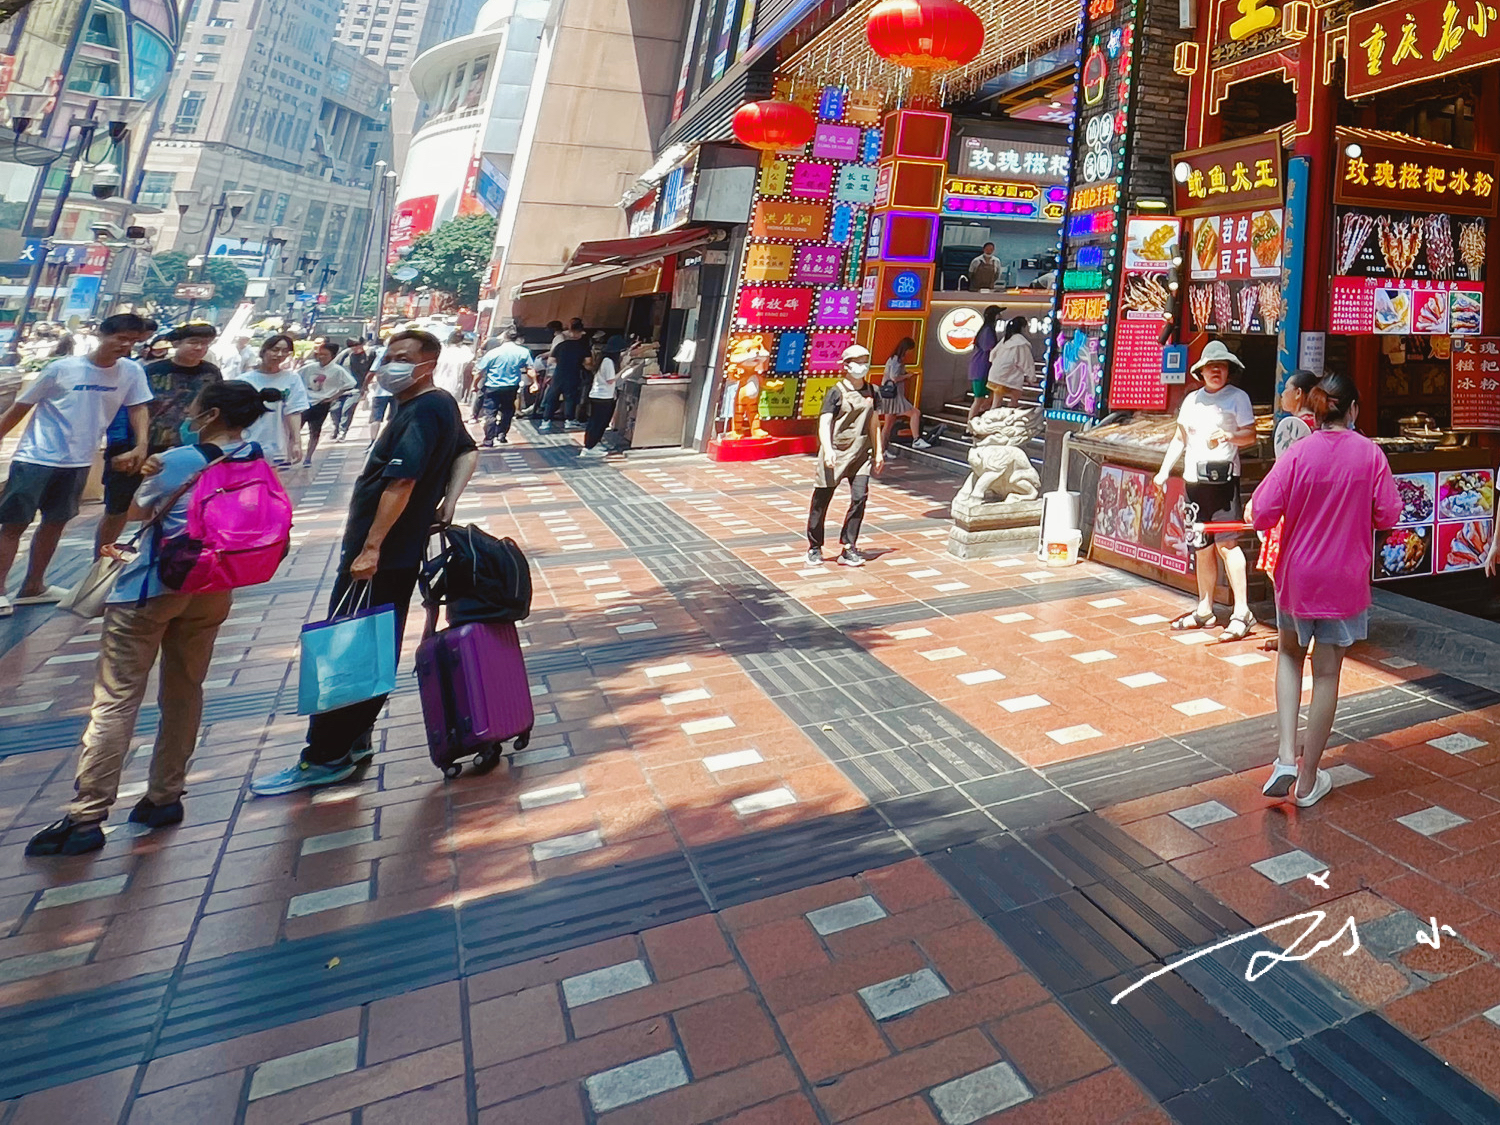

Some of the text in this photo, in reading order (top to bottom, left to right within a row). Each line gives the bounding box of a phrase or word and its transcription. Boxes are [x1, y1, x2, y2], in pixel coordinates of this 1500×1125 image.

[1187, 158, 1278, 199] 鱿鱼大王
[1345, 156, 1494, 198] 玫瑰糍粑冰粉
[1219, 248, 1248, 274] 豆干
[751, 295, 799, 310] 解放碑
